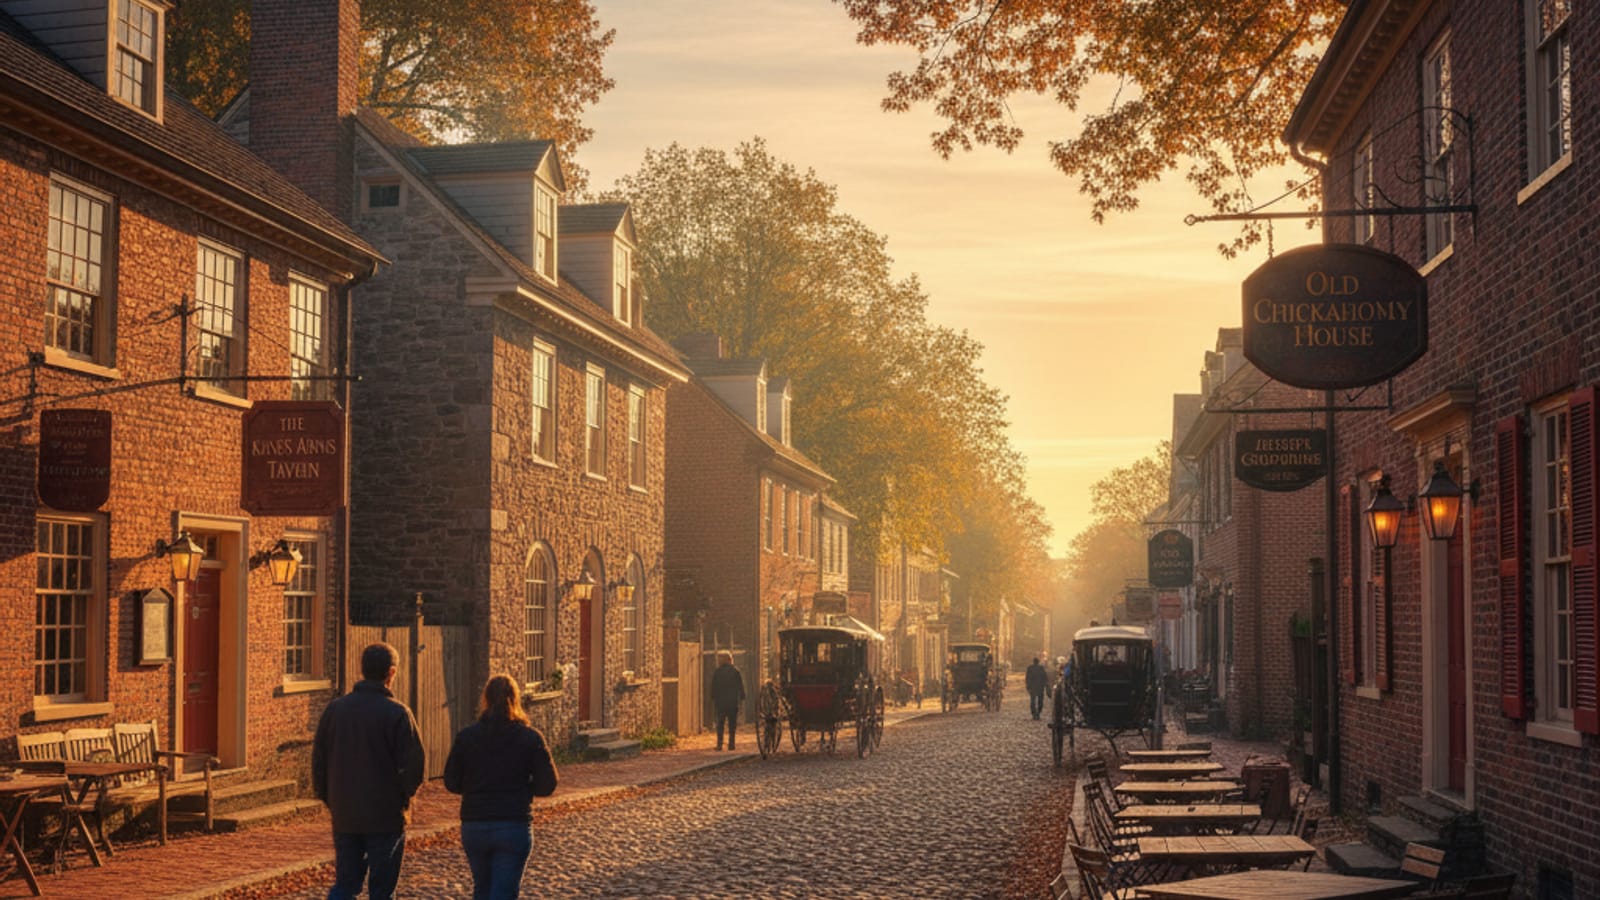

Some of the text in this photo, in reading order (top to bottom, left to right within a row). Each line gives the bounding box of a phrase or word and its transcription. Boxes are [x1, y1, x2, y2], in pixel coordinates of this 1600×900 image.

[1306, 271, 1359, 296] OLD
[1253, 299, 1413, 324] CHICKAHOMY
[1294, 324, 1375, 347] HOUSE
[280, 417, 305, 431] THE
